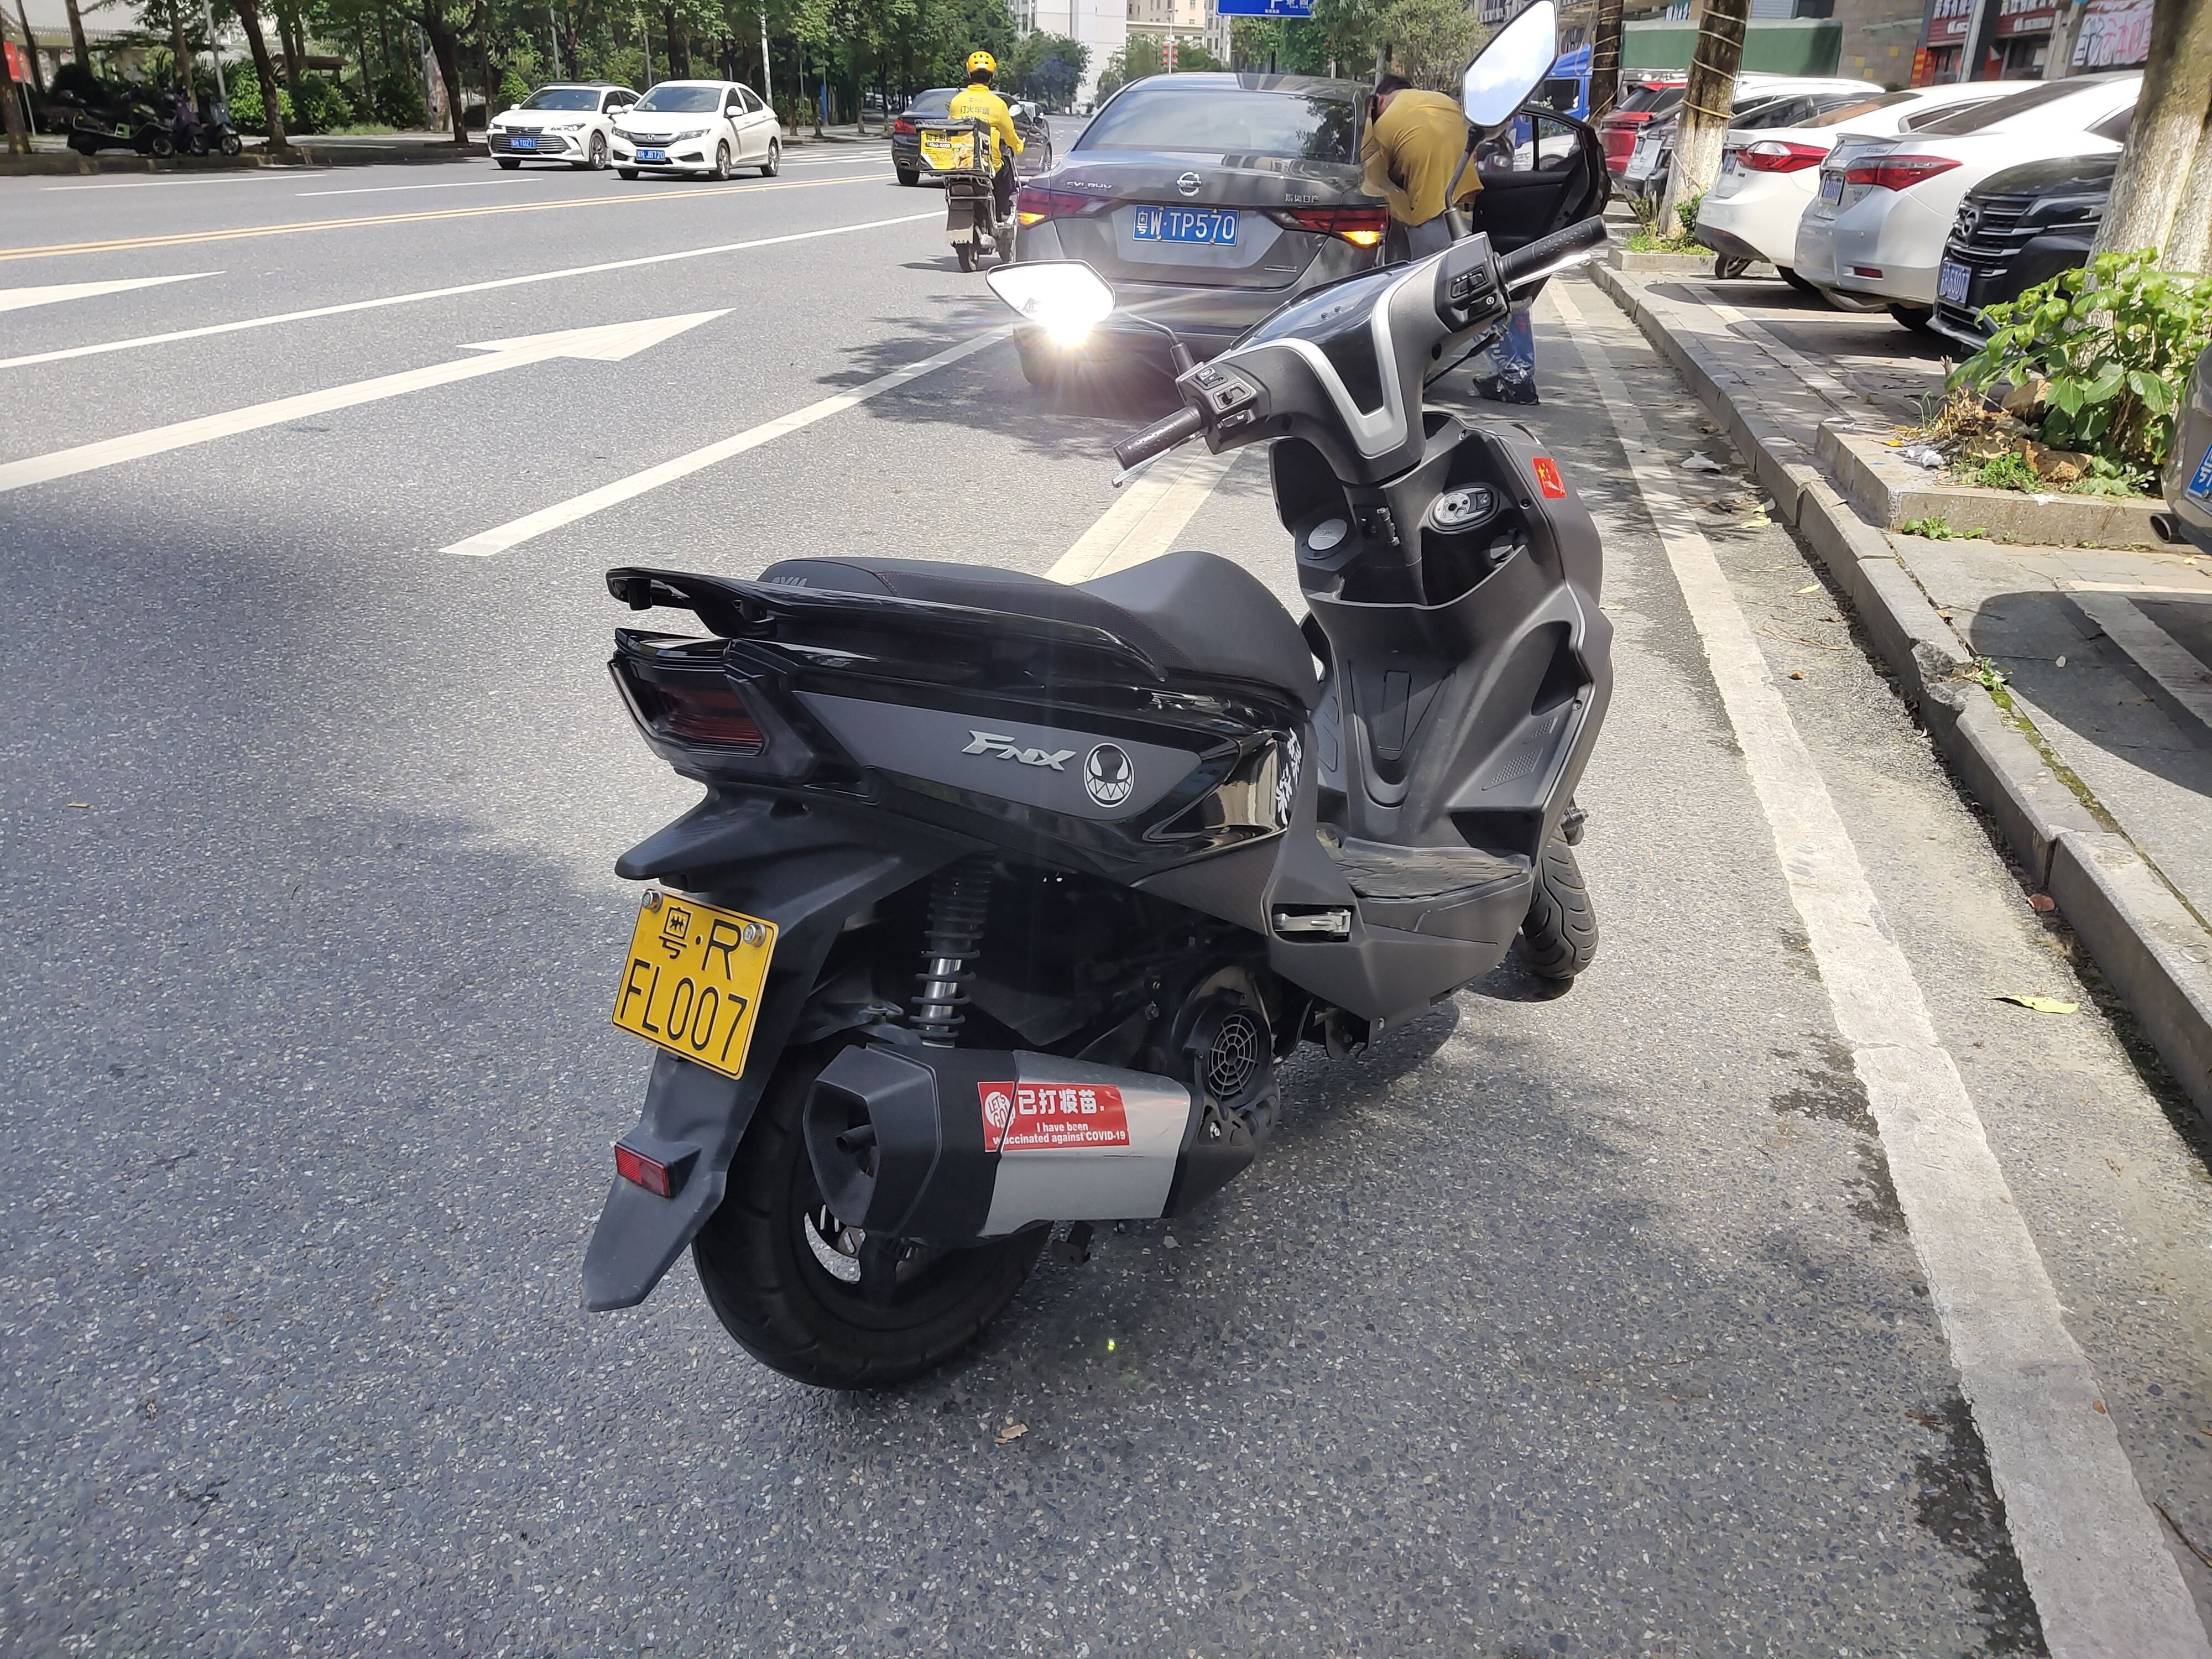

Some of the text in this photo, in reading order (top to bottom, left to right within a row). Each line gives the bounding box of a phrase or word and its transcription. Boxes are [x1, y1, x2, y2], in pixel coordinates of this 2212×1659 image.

[961, 730, 1077, 771] FNX
[619, 958, 748, 1062] FL007
[1036, 1121, 1089, 1133] I have been
[1052, 1133, 1084, 1144] against
[1086, 1130, 1126, 1141] COVID-19
